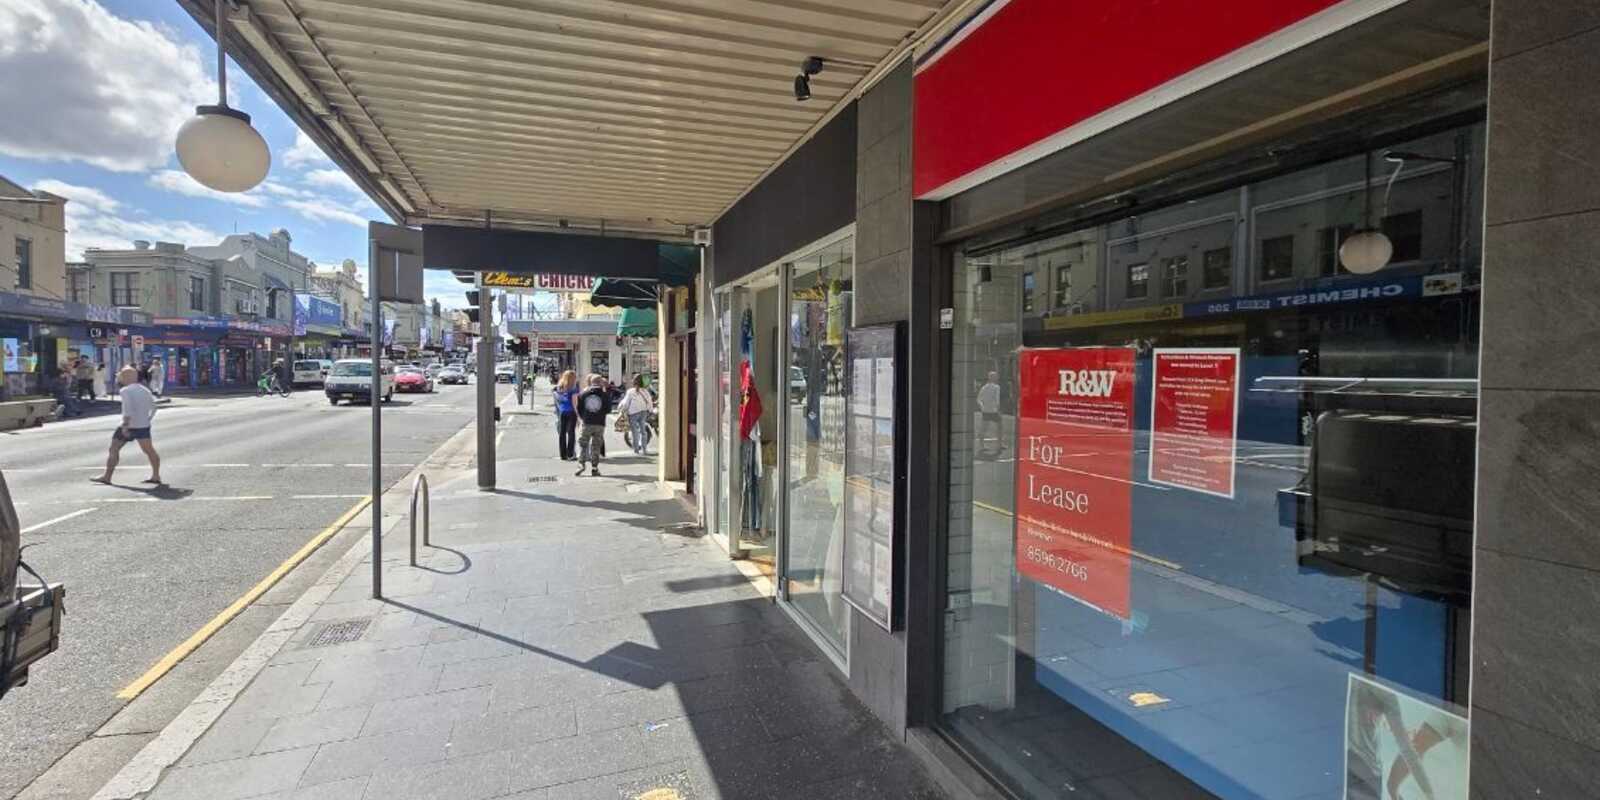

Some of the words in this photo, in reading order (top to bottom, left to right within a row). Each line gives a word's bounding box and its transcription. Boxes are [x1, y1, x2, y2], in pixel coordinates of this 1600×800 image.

[1058, 369, 1117, 397] R&W
[1028, 436, 1063, 464] For
[1028, 474, 1088, 514] Lease
